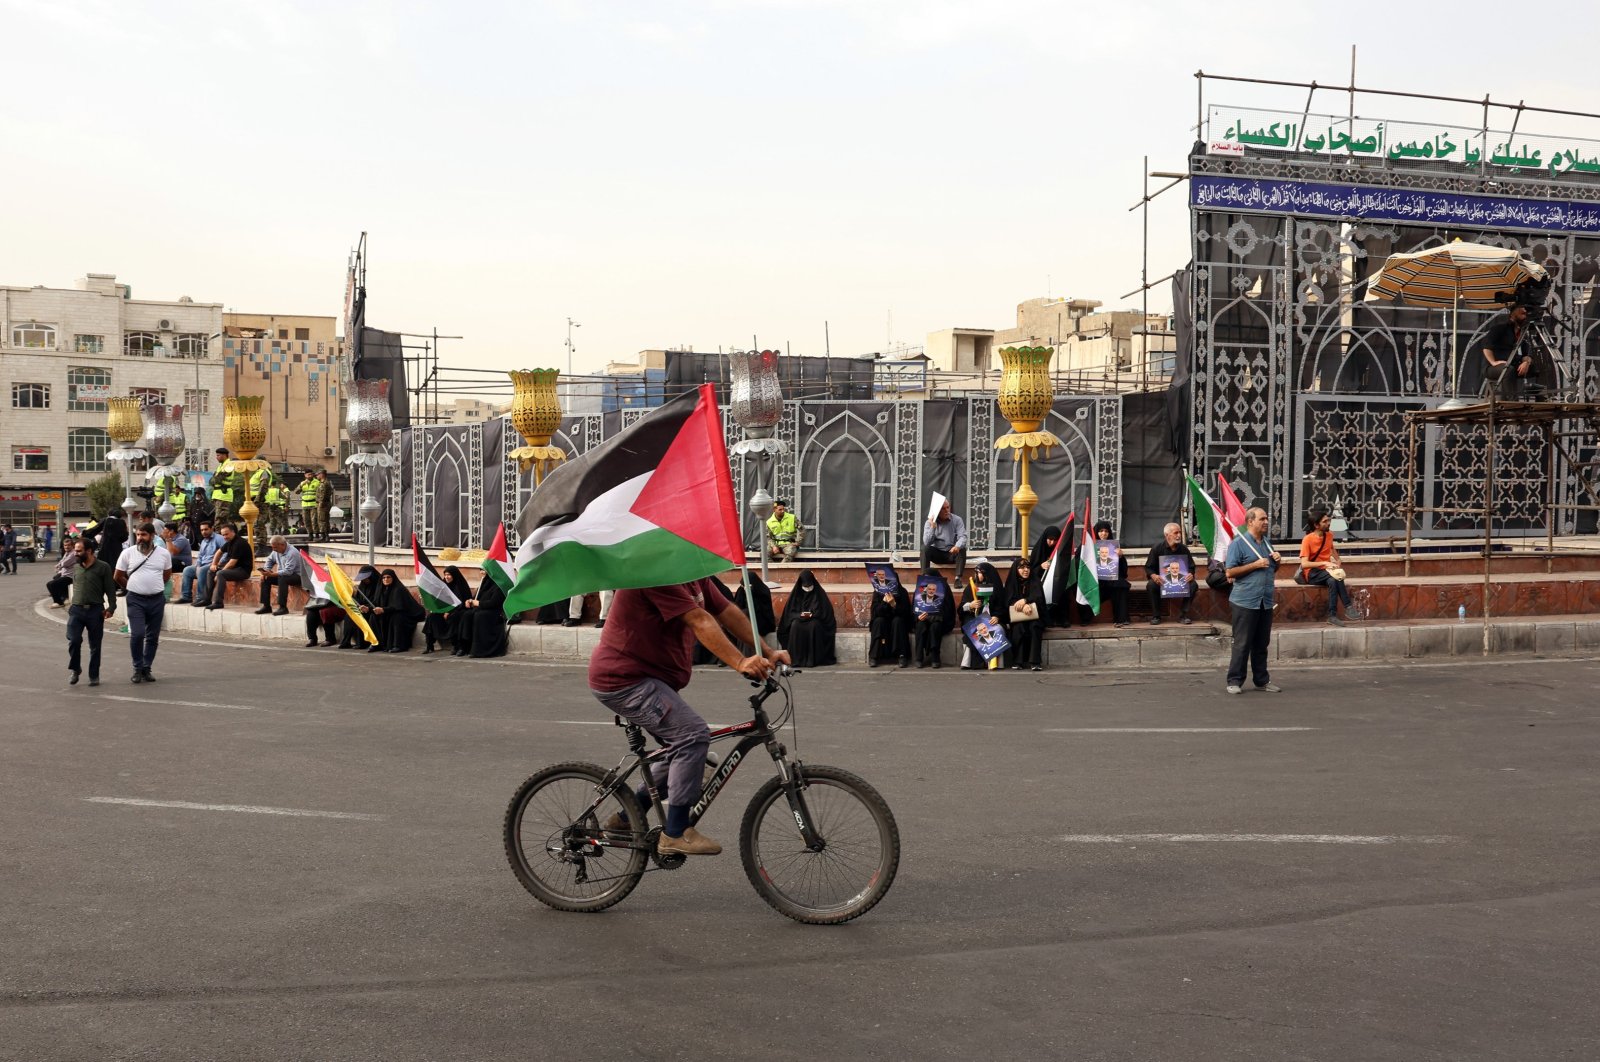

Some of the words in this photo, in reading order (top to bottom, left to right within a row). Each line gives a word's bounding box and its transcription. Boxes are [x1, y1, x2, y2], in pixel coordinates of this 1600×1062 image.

[1211, 143, 1231, 151] السلام
[1223, 119, 1297, 148] الكساء
[1302, 122, 1384, 156] أصحاب
[1387, 131, 1457, 160] خامس
[1464, 139, 1481, 168] يا
[1489, 142, 1543, 173] عليك
[693, 749, 742, 816] OVERLORD
